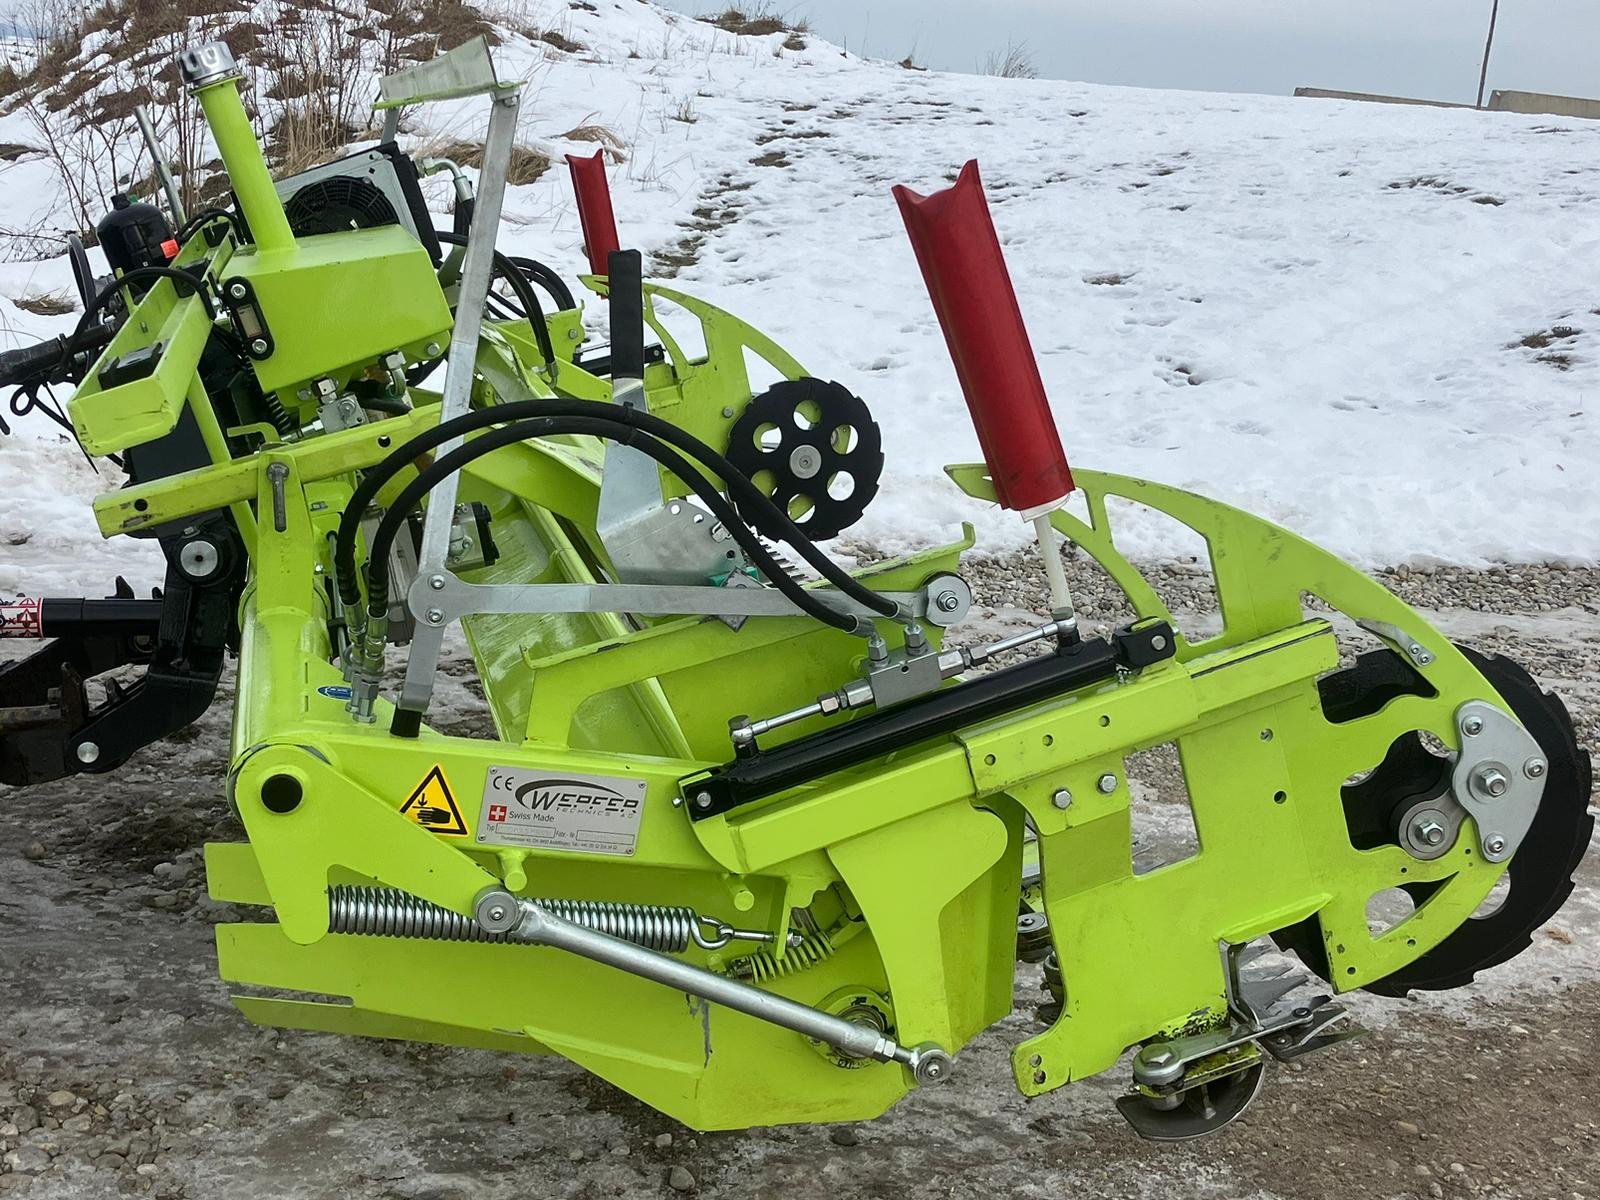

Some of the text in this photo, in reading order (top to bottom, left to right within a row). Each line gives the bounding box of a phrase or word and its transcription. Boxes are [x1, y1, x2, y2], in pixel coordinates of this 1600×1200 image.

[493, 775, 514, 791] CE
[531, 790, 639, 813] WEPFER
[508, 811, 555, 822] Swiss Made
[556, 807, 611, 817] TECHNICS
